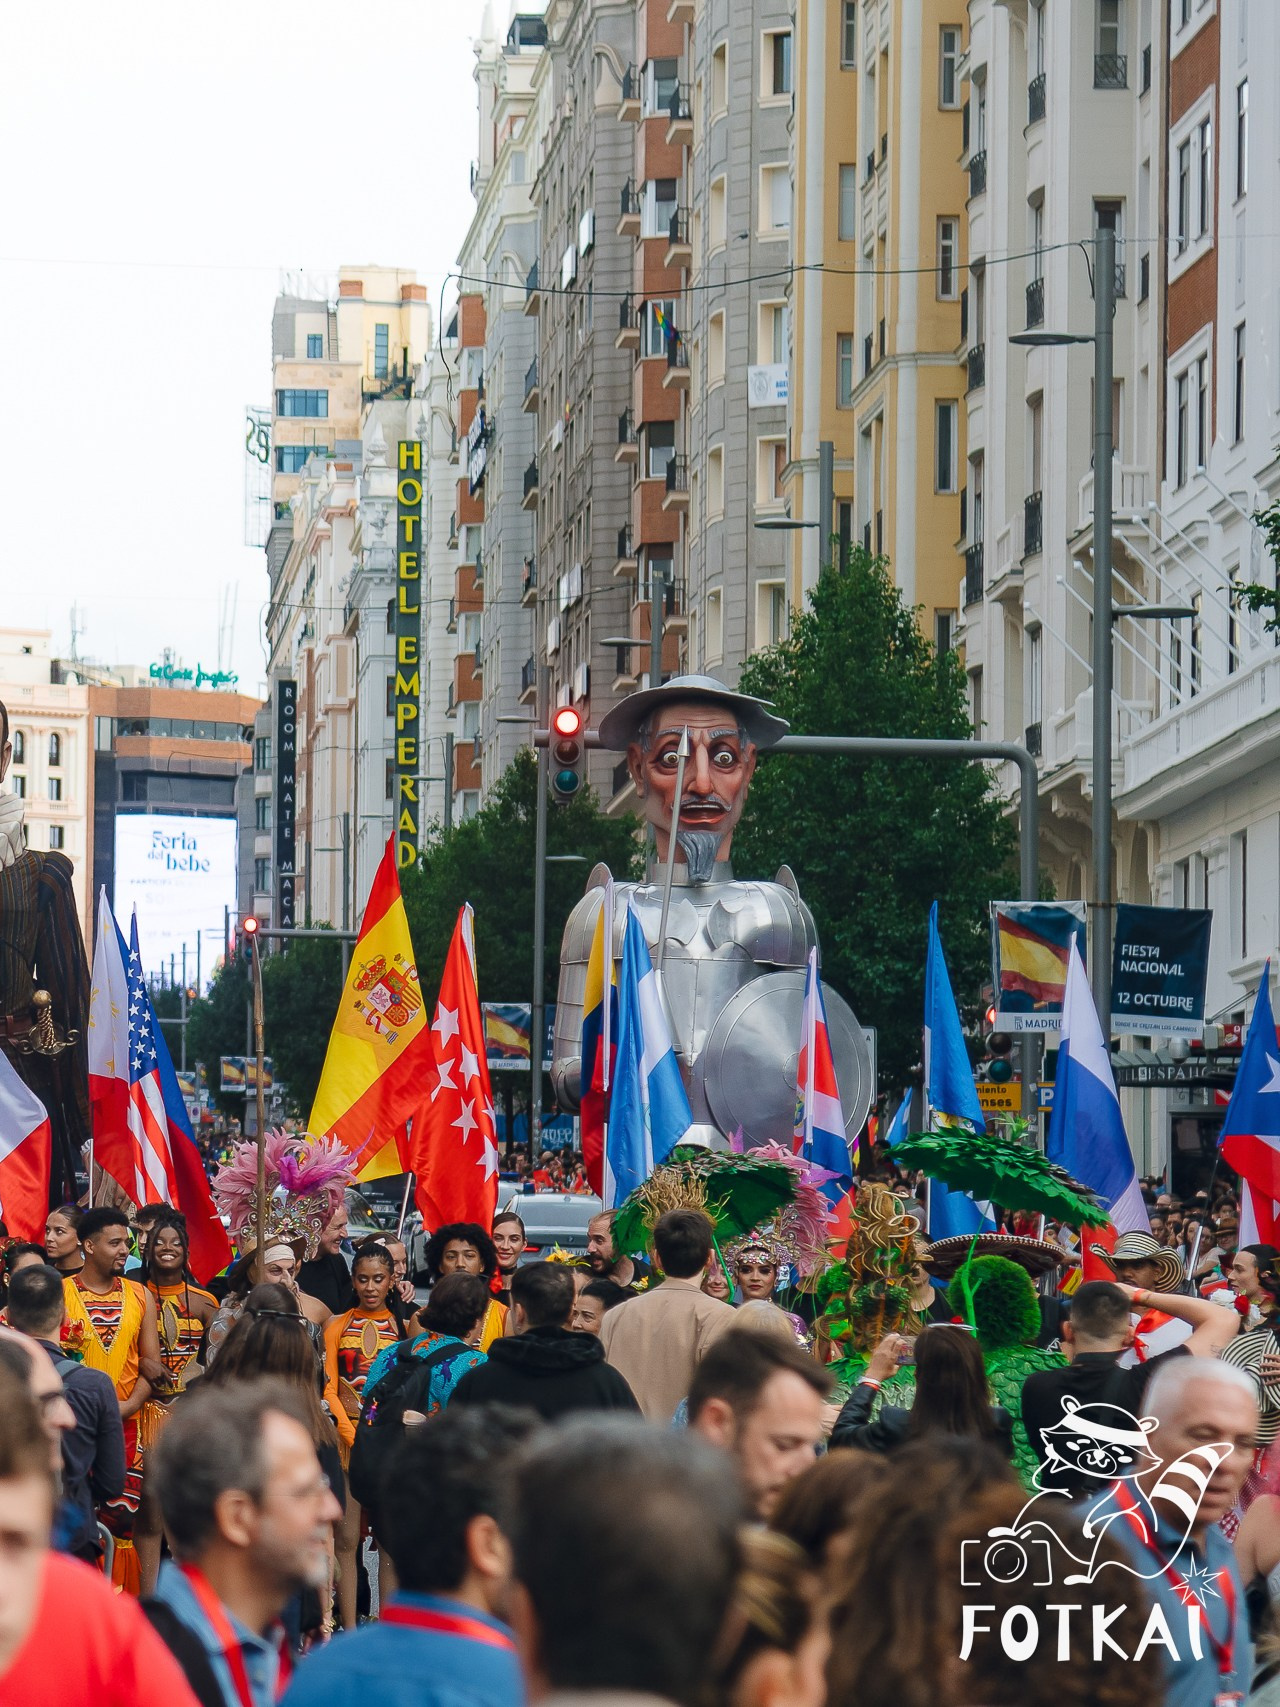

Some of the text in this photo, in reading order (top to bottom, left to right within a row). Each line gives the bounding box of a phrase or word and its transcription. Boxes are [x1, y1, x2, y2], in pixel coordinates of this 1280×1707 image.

[397, 443, 422, 614] HOTEL
[283, 687, 294, 751] ROOM
[394, 636, 420, 868] EMPERAD
[283, 775, 293, 838] MATE
[152, 830, 197, 851] Feria
[1122, 943, 1160, 959] FIESTA
[1120, 960, 1185, 977] NACIONAL
[1118, 992, 1194, 1012] 12 OCTUBRE
[976, 1085, 1007, 1094] miento
[1040, 1088, 1055, 1106] P
[980, 1098, 1012, 1107] nses
